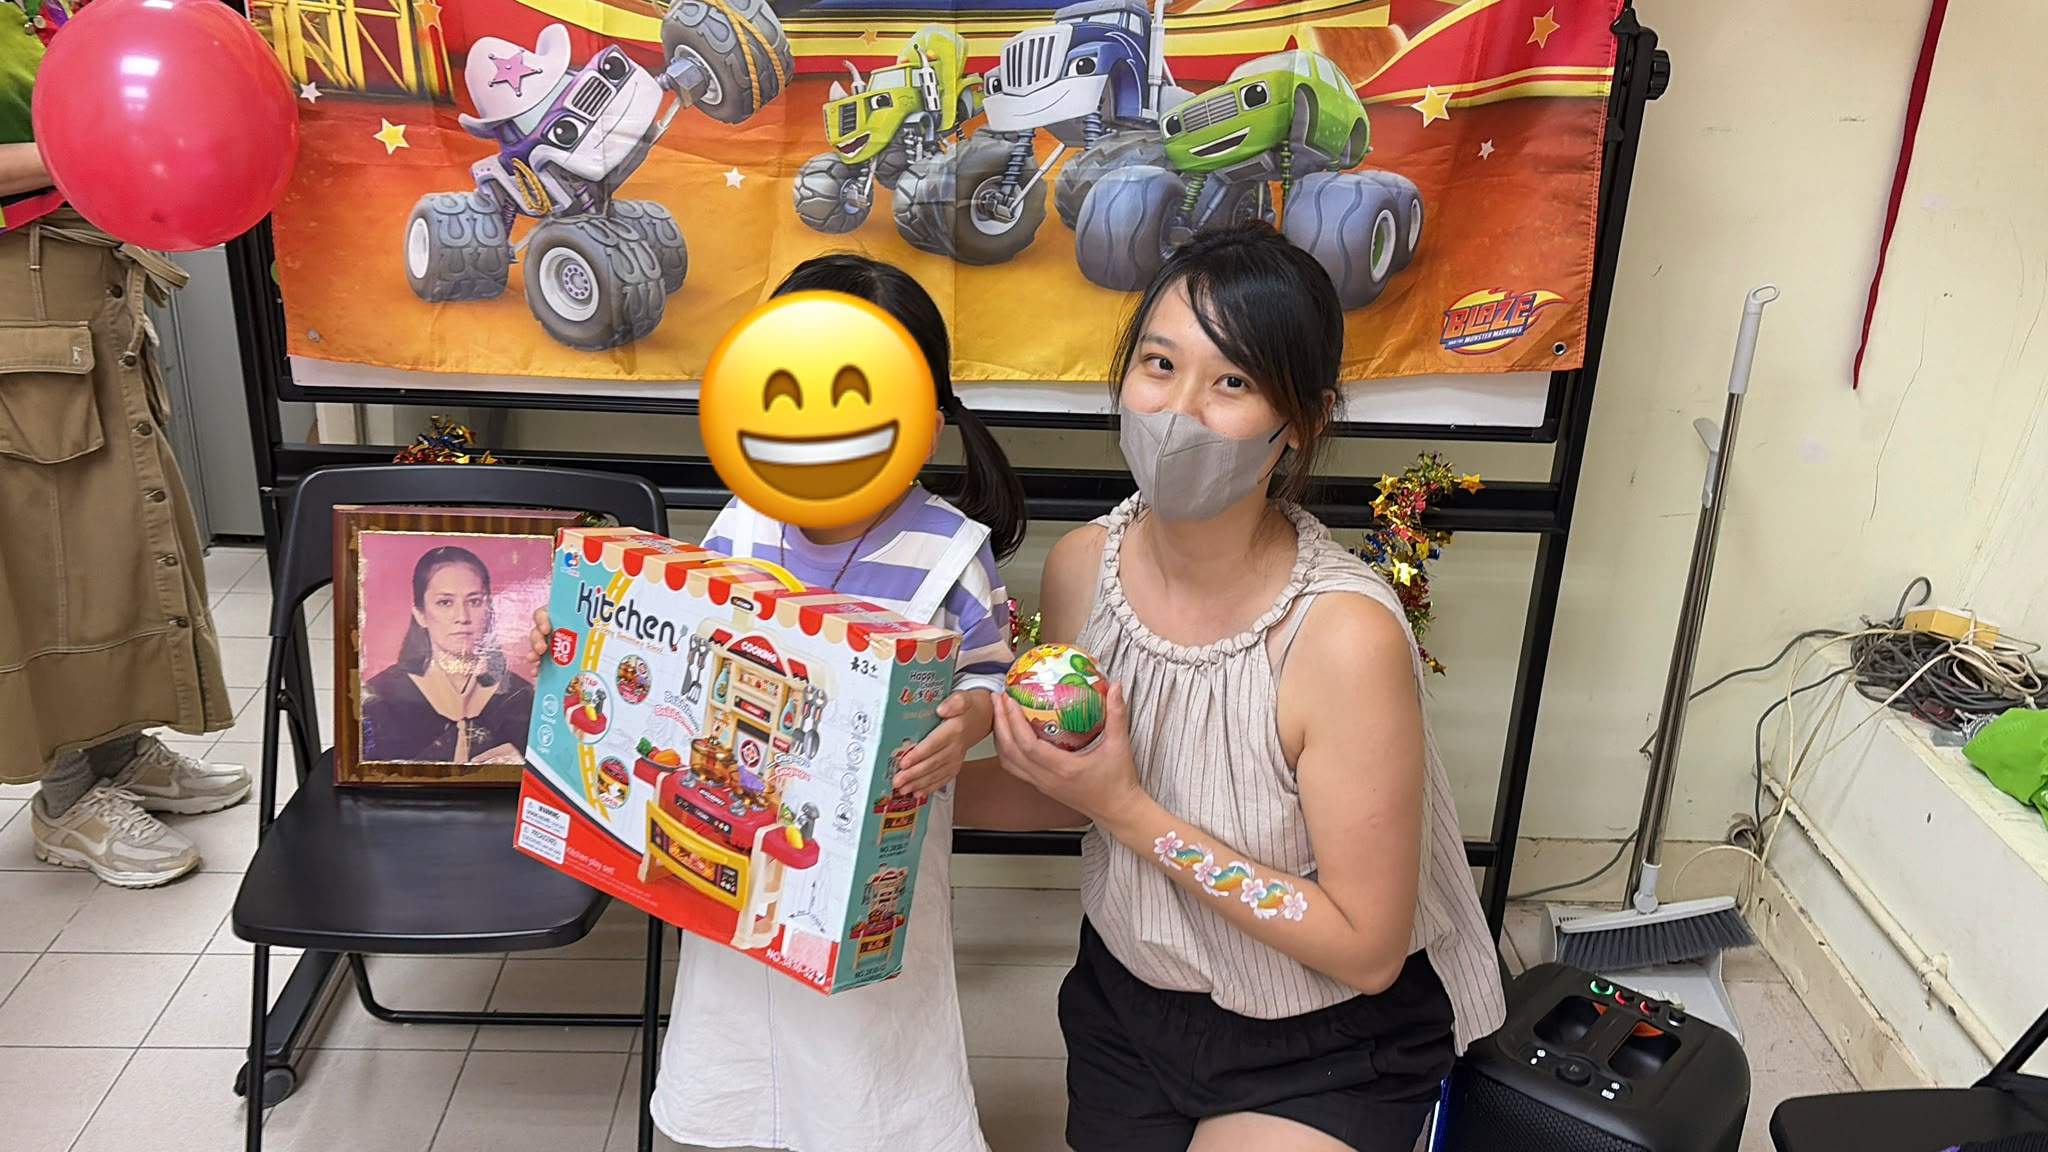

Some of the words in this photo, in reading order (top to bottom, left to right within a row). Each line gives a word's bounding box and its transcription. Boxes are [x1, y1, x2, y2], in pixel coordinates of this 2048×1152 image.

[1442, 295, 1534, 339] BLAZE
[577, 582, 675, 650] Kitchen
[553, 637, 571, 655] 30
[741, 641, 777, 663] COOKING
